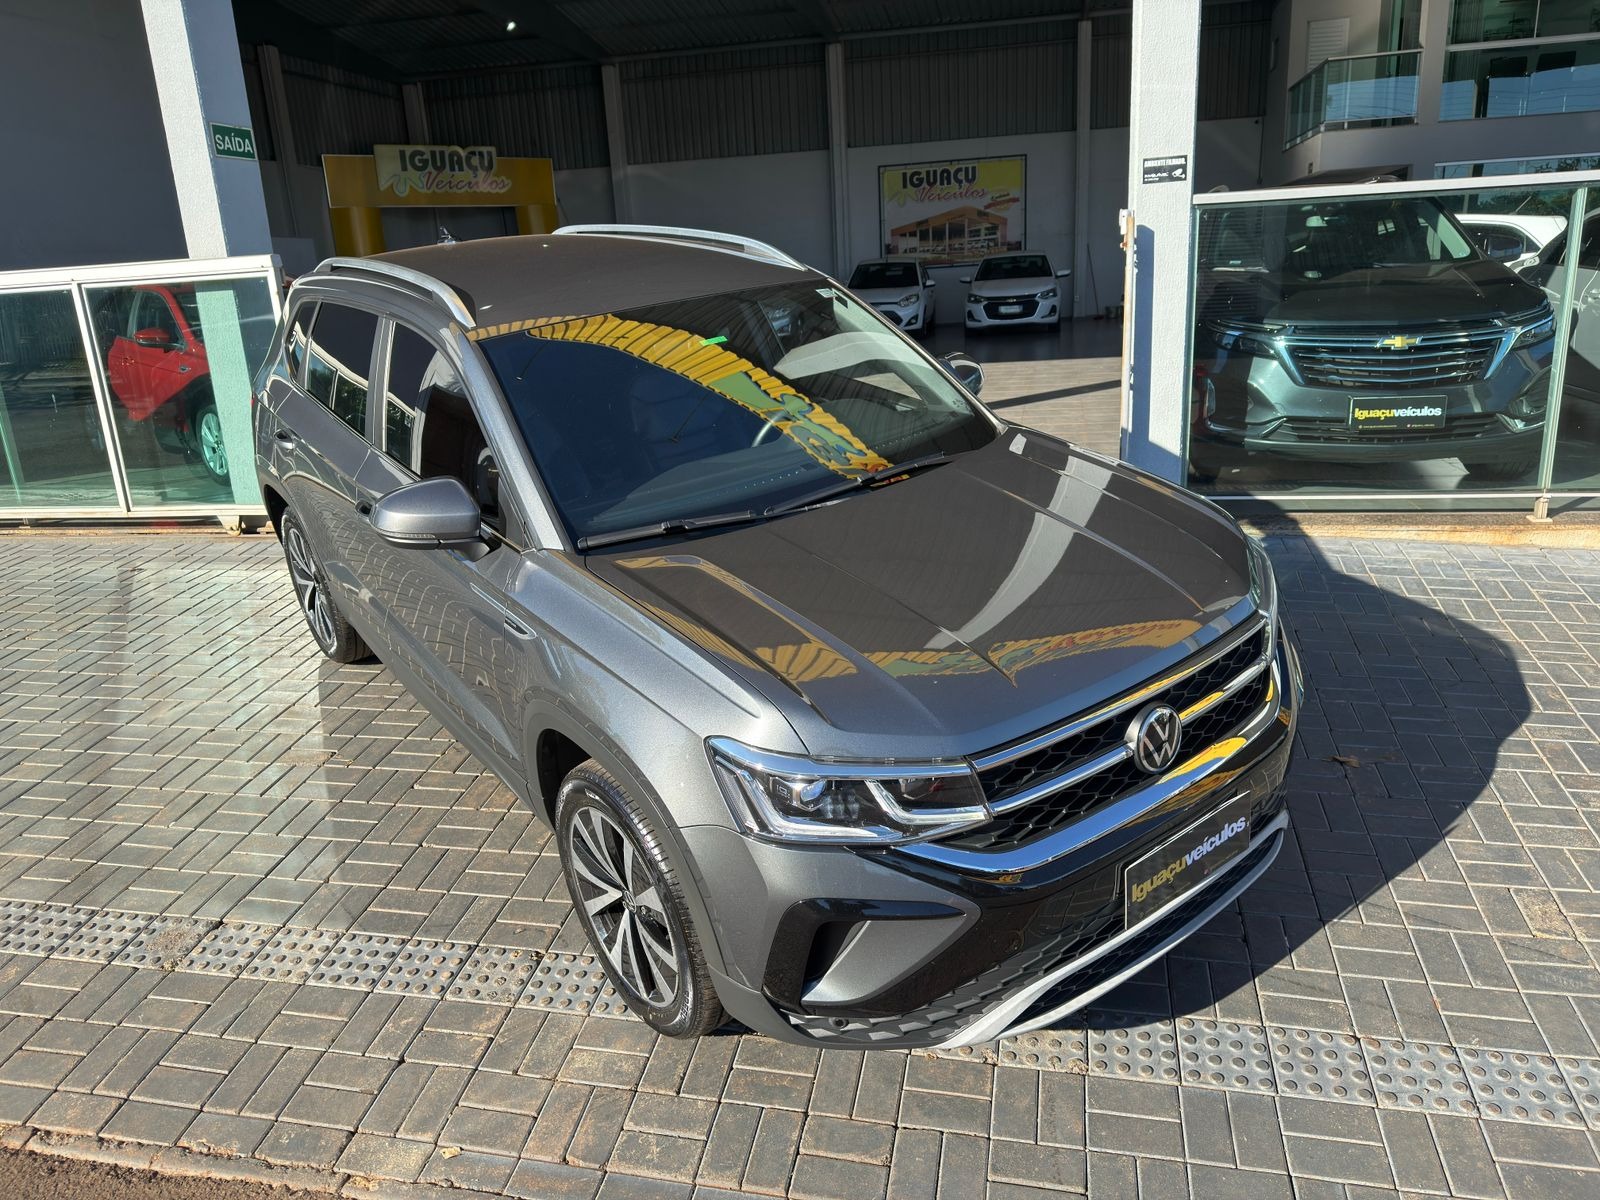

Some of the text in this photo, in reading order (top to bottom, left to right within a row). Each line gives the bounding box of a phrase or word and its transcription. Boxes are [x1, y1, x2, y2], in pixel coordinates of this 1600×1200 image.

[215, 132, 254, 154] SAÍDA
[399, 149, 494, 178] IGUAÇU
[902, 166, 977, 190] IGUAÇU
